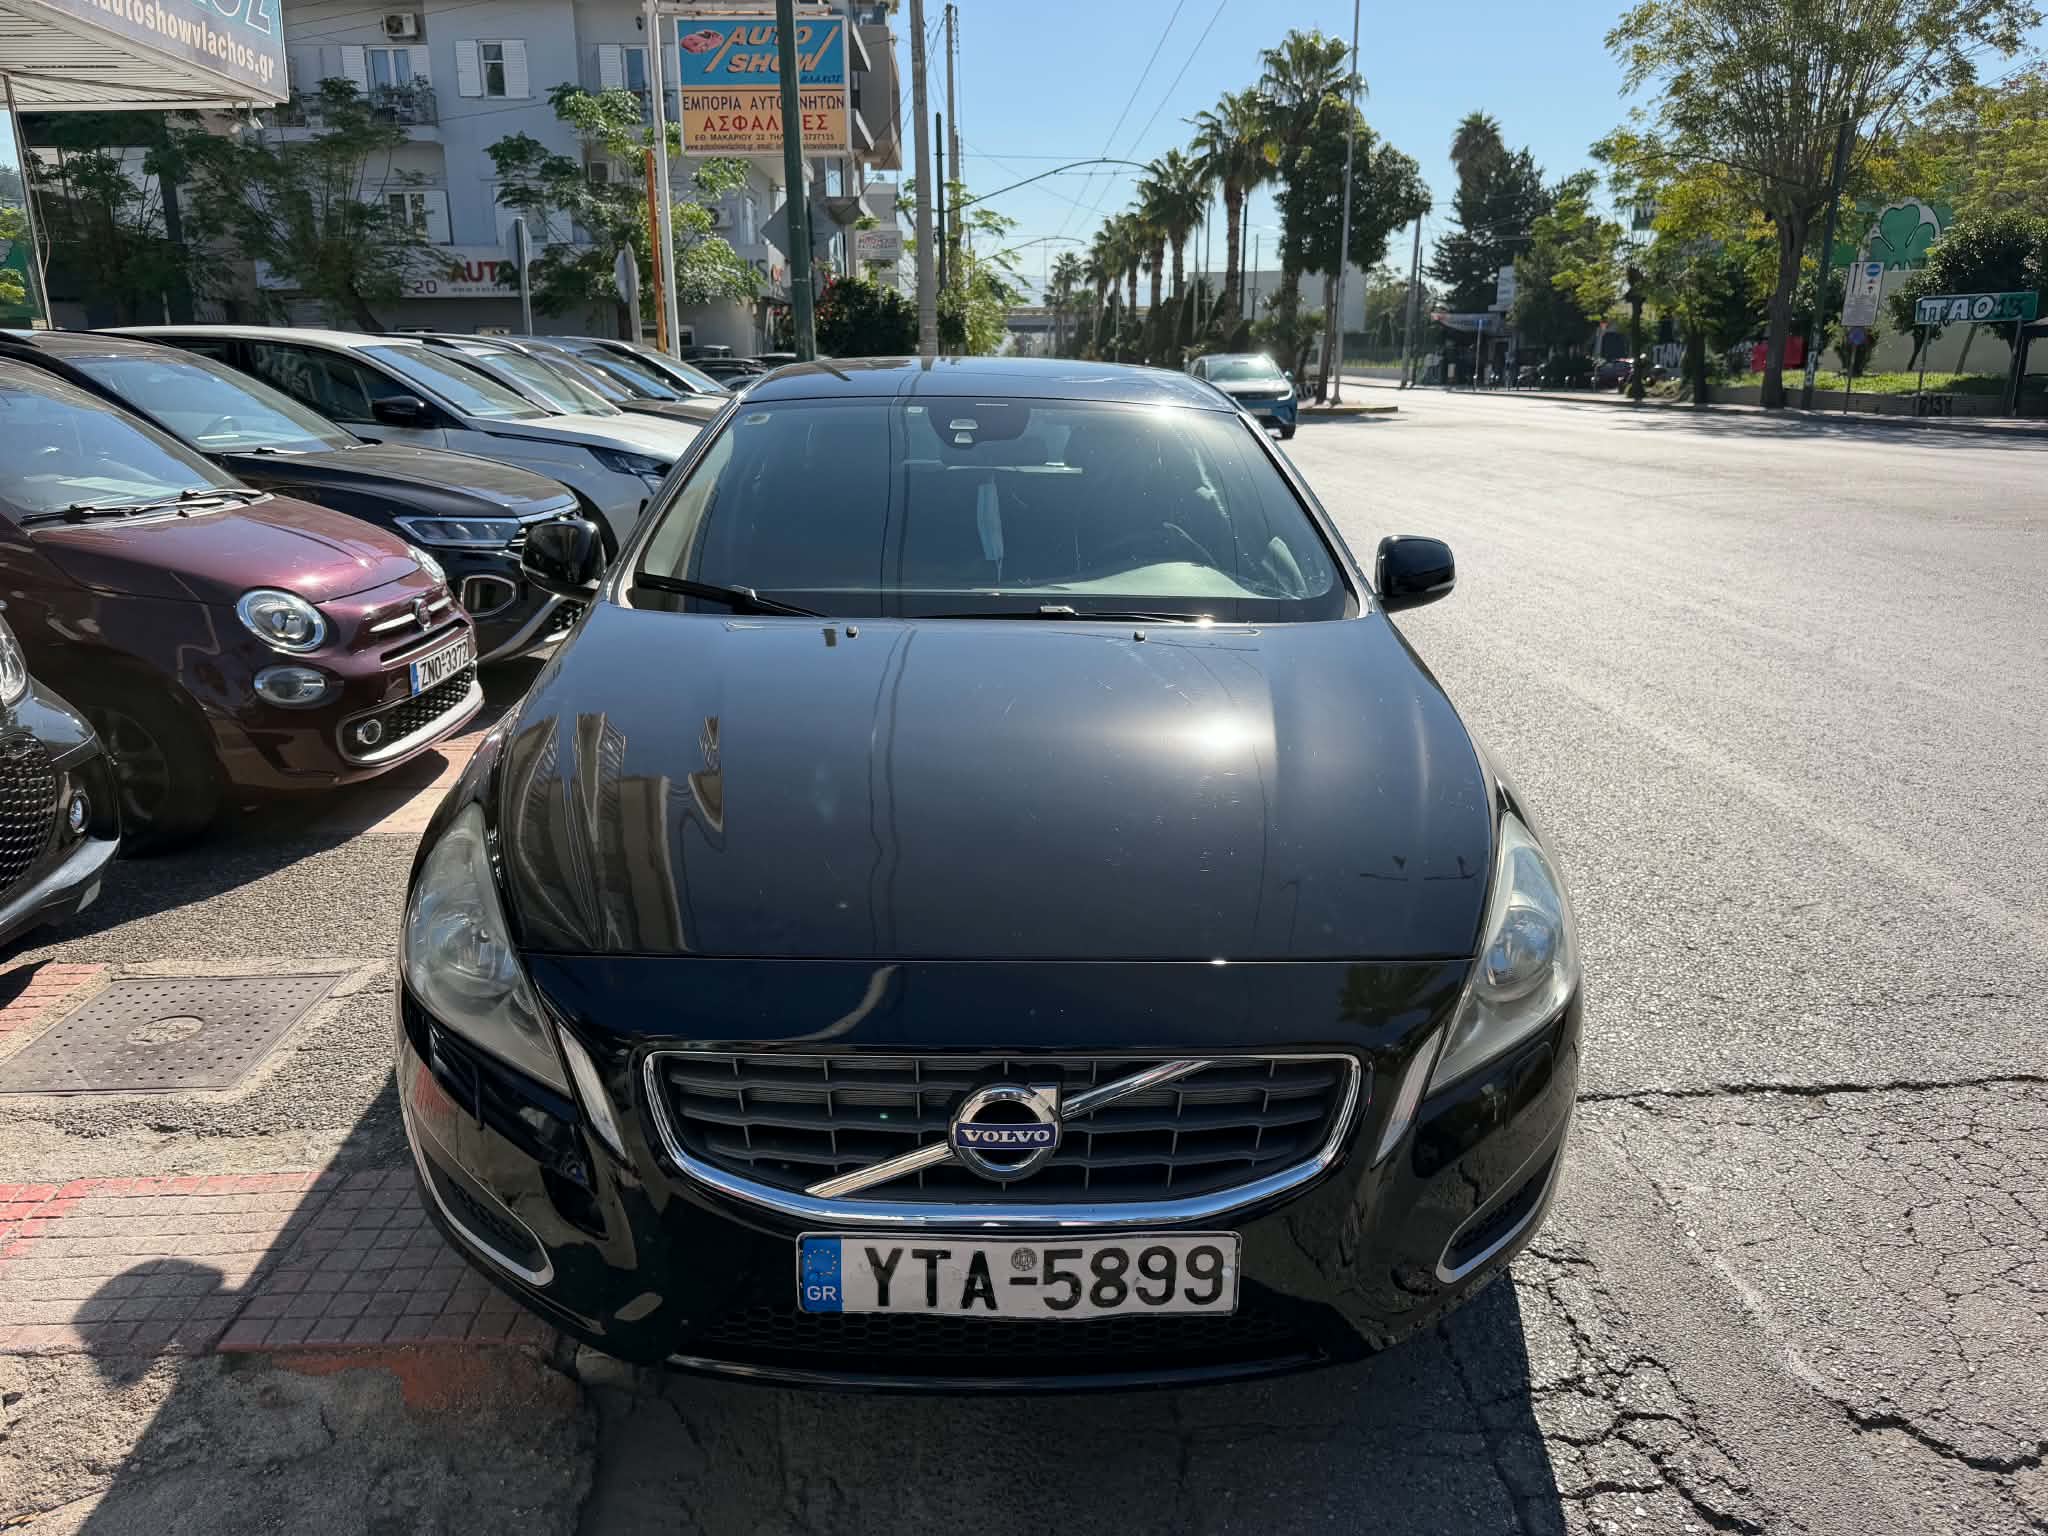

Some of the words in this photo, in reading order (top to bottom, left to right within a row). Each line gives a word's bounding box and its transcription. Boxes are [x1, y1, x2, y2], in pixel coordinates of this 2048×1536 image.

[683, 96, 742, 111] ΕΜΠΟΡΙΑ
[750, 95, 845, 110] ΑΥΤΟΝΗΤΩΝ
[703, 113, 829, 132] ΑΣΦΑΛΕΣ
[415, 280, 438, 294] 20
[960, 1128, 1051, 1144] VOLVO
[806, 1285, 837, 1301] GR
